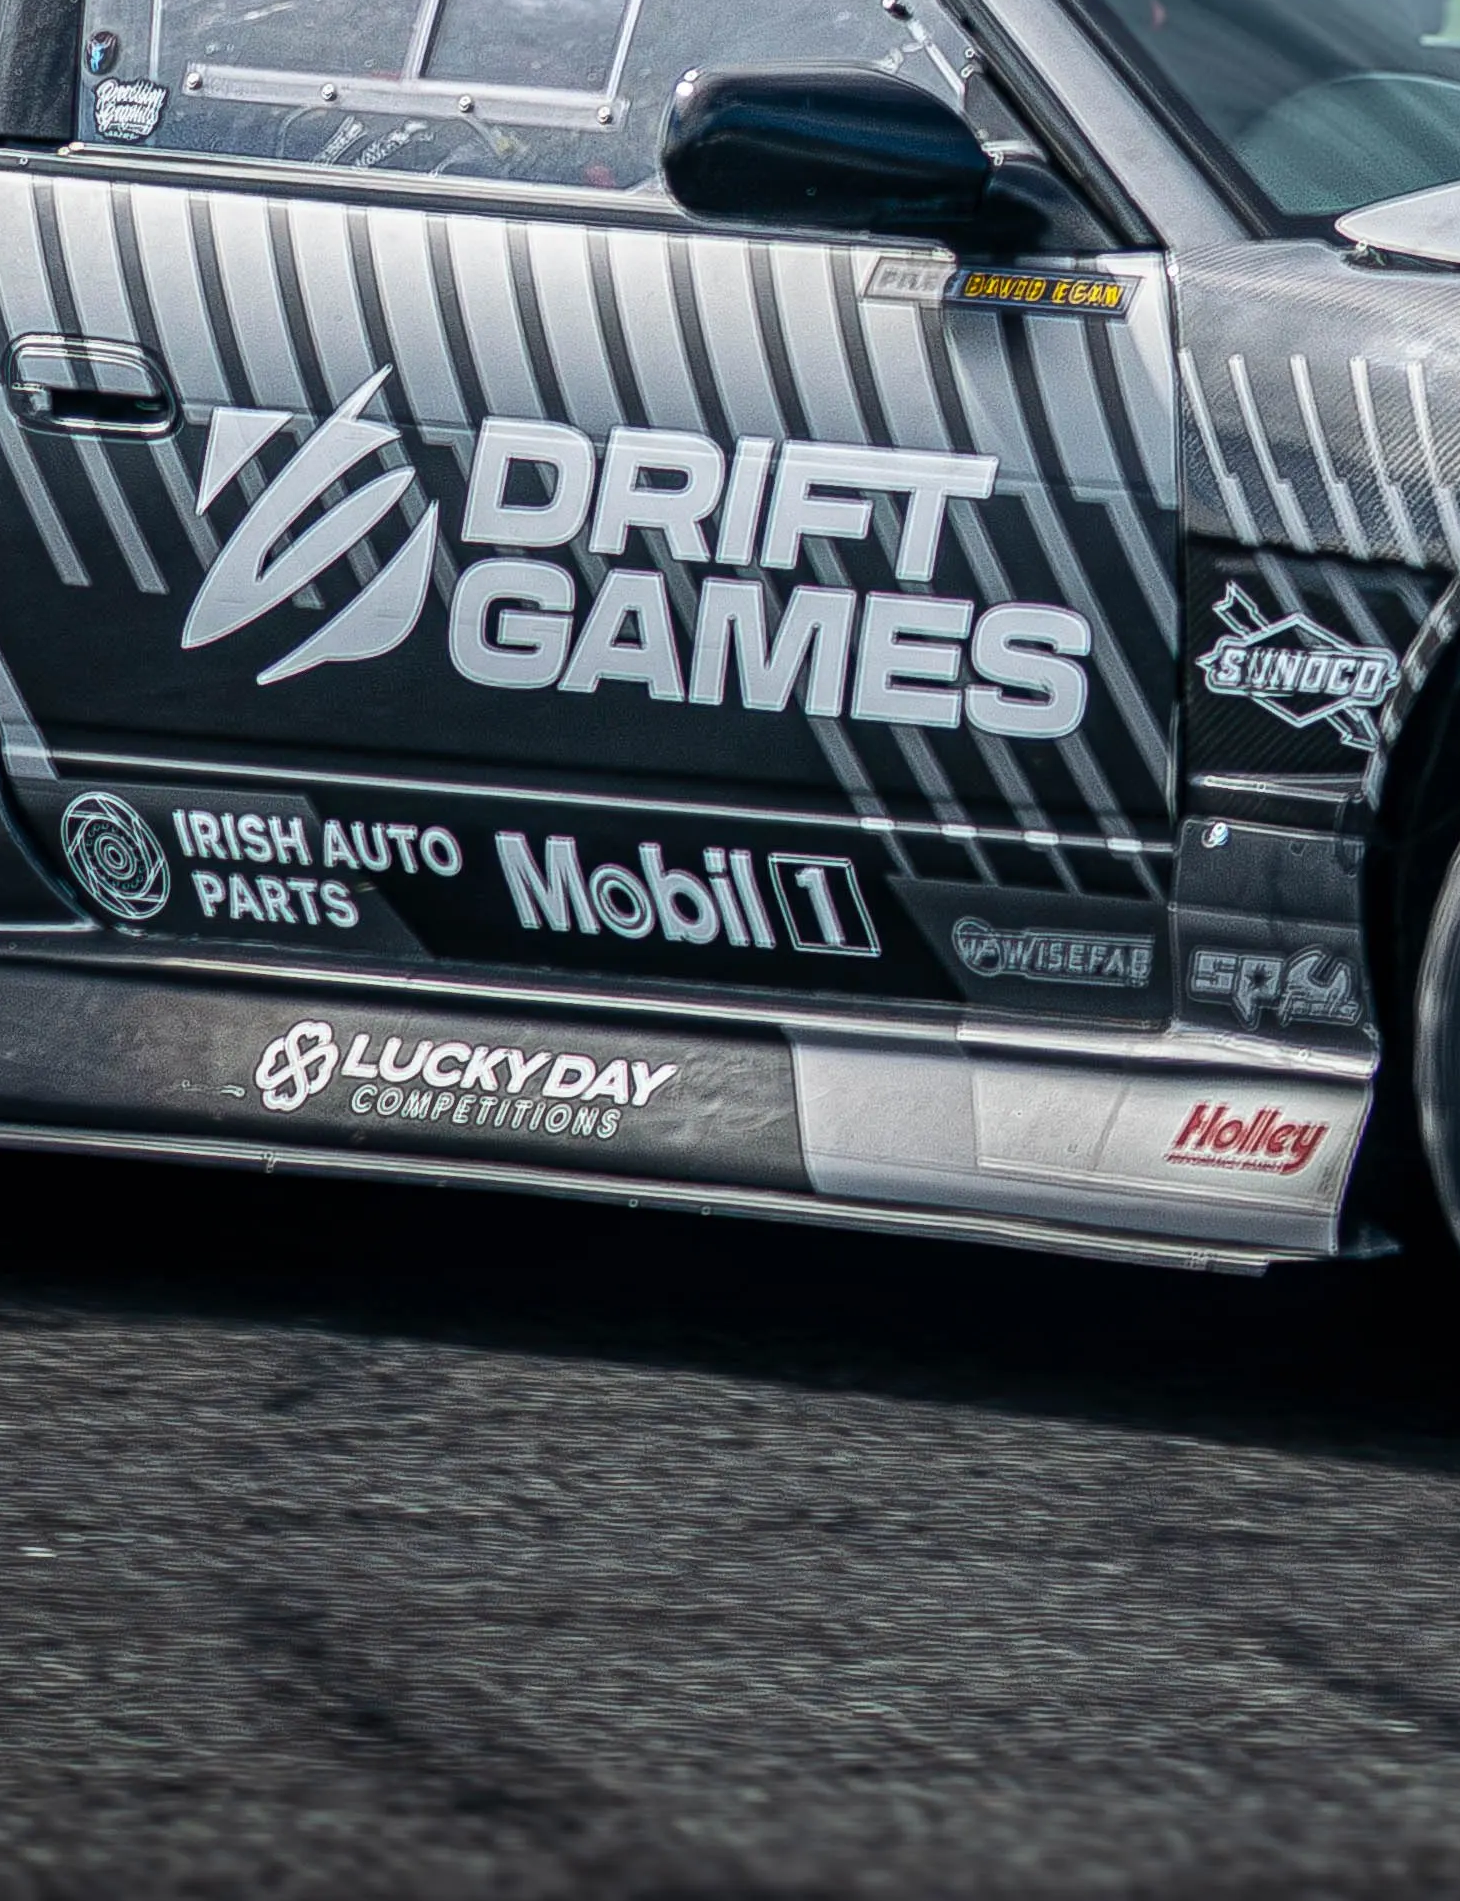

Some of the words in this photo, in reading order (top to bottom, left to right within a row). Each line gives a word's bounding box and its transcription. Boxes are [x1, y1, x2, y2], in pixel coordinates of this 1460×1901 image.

[460, 416, 1000, 584] DRIFT
[447, 557, 1092, 740] GAMES
[1216, 650, 1386, 694] SUNOCO
[171, 809, 312, 867] IRISH
[322, 819, 463, 878] AUTO
[192, 871, 361, 929] PARTS
[494, 830, 778, 951] Mobil
[794, 864, 846, 948] 1
[1007, 936, 1155, 988] WISEFAB
[341, 1032, 554, 1098] LUCKY
[547, 1053, 680, 1108] DAY
[348, 1084, 623, 1141] COMPETITIONS
[1171, 1100, 1330, 1175] Holley
